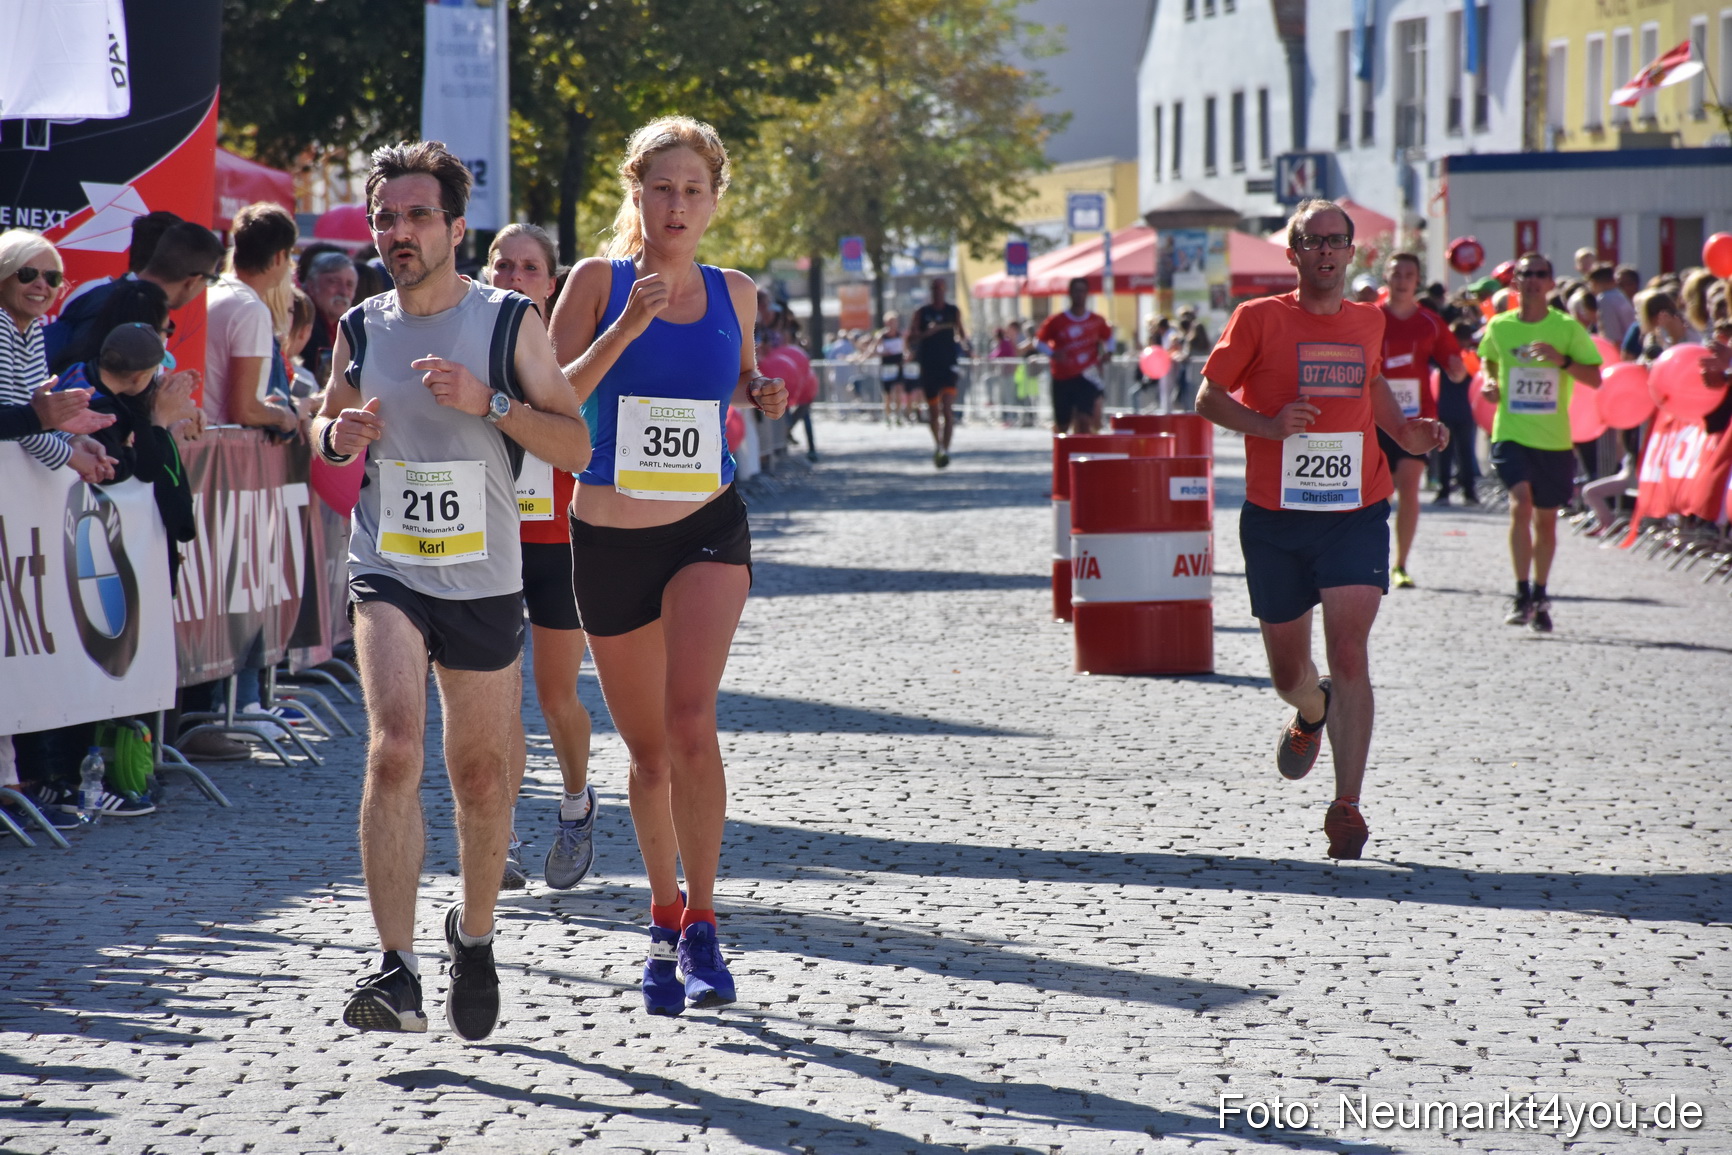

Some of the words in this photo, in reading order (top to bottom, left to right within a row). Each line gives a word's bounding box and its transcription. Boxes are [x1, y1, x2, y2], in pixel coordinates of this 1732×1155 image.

[16, 207, 70, 229] NEXT
[1303, 364, 1364, 384] 0774600
[1516, 379, 1553, 396] 2172
[650, 407, 695, 418] BOCK
[643, 426, 700, 458] 350
[1308, 440, 1343, 449] BOCK
[1295, 454, 1352, 479] 2268
[406, 470, 453, 482] BOCK
[1301, 491, 1344, 502] Christian
[402, 489, 460, 522] 216
[402, 523, 422, 533] PARTL
[422, 526, 455, 534] Neumarkt
[419, 540, 445, 554] Karl
